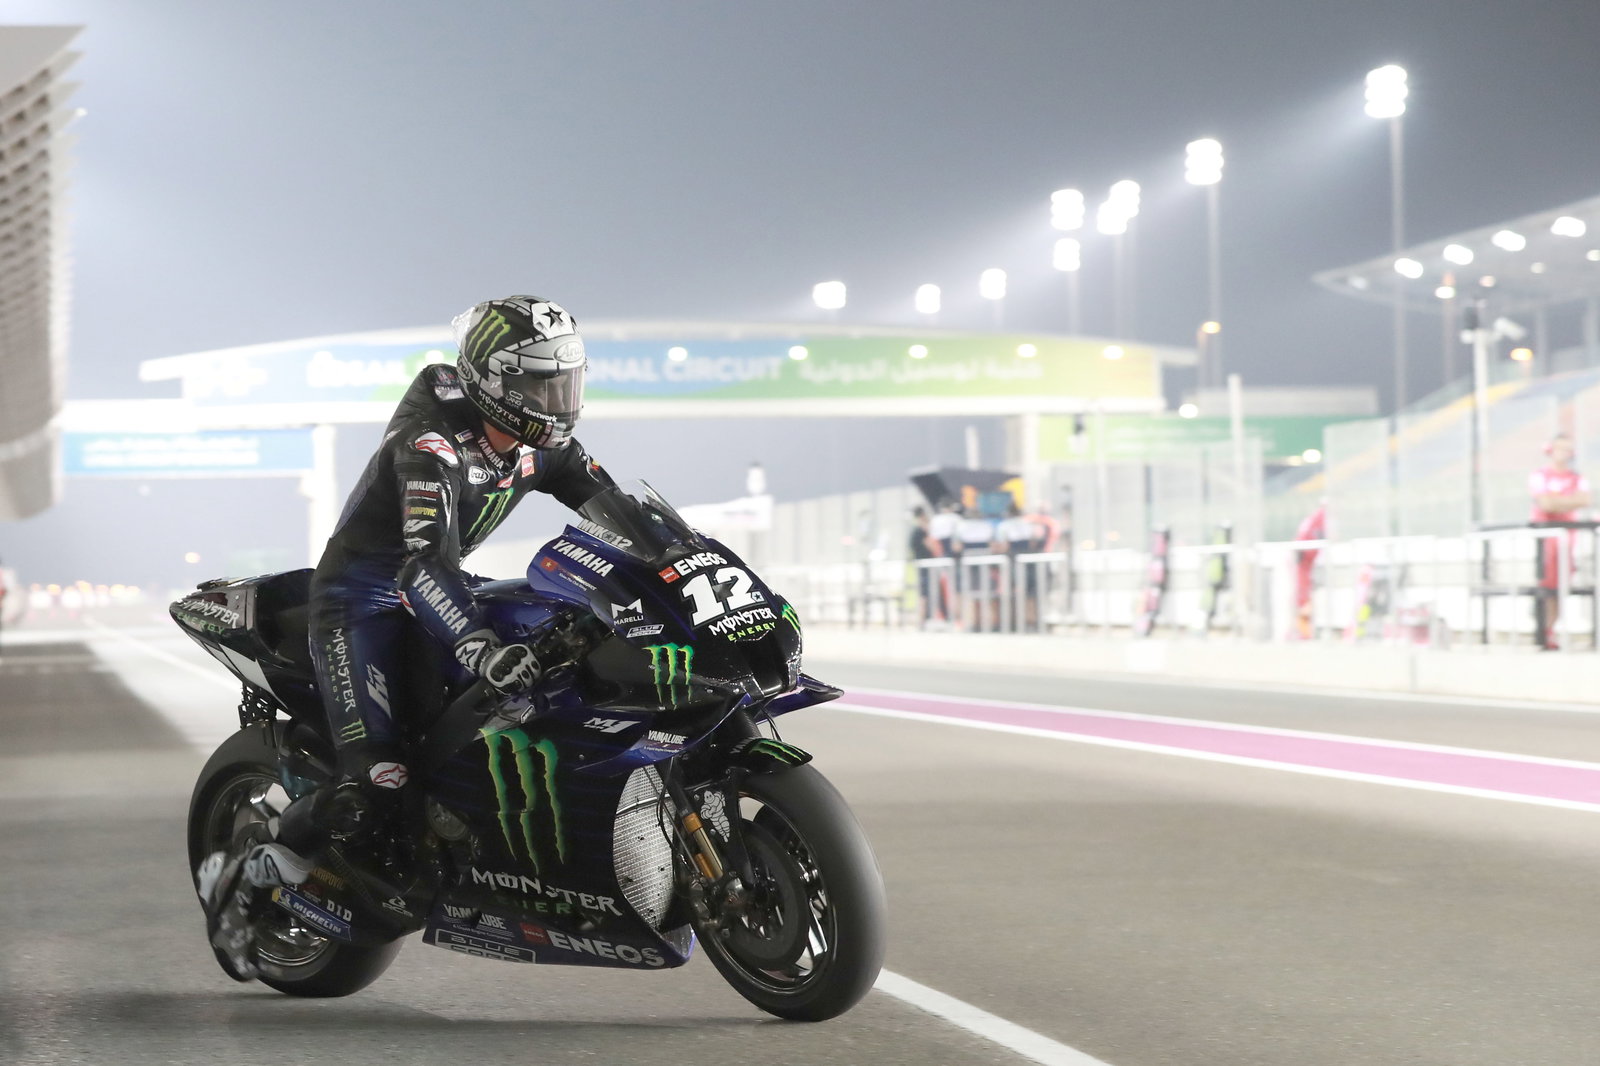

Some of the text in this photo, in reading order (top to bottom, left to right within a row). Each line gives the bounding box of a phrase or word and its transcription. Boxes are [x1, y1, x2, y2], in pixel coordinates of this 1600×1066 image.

[478, 389, 521, 426] MONSTER
[522, 406, 558, 423] finetwork
[477, 436, 504, 470] YAMAHA
[406, 480, 440, 493] YAMALUBE
[552, 539, 614, 577] YAMAHA
[673, 552, 727, 576] ENEOS
[412, 568, 469, 635] YAMAHA
[681, 566, 765, 626] 12
[180, 599, 240, 629] MONSTER
[613, 614, 644, 626] MARELLI
[708, 607, 777, 636] MONSTER
[727, 621, 776, 641] ENERGY
[325, 644, 340, 703] ENERGY
[332, 628, 356, 713] MONSTER
[647, 729, 686, 745] YAMALUBE
[471, 866, 623, 917] MONSTER
[293, 902, 342, 934] MICHELIN
[442, 903, 507, 931] YAMUBE
[450, 934, 520, 957] BLUE
[546, 929, 666, 967] ENEOS
